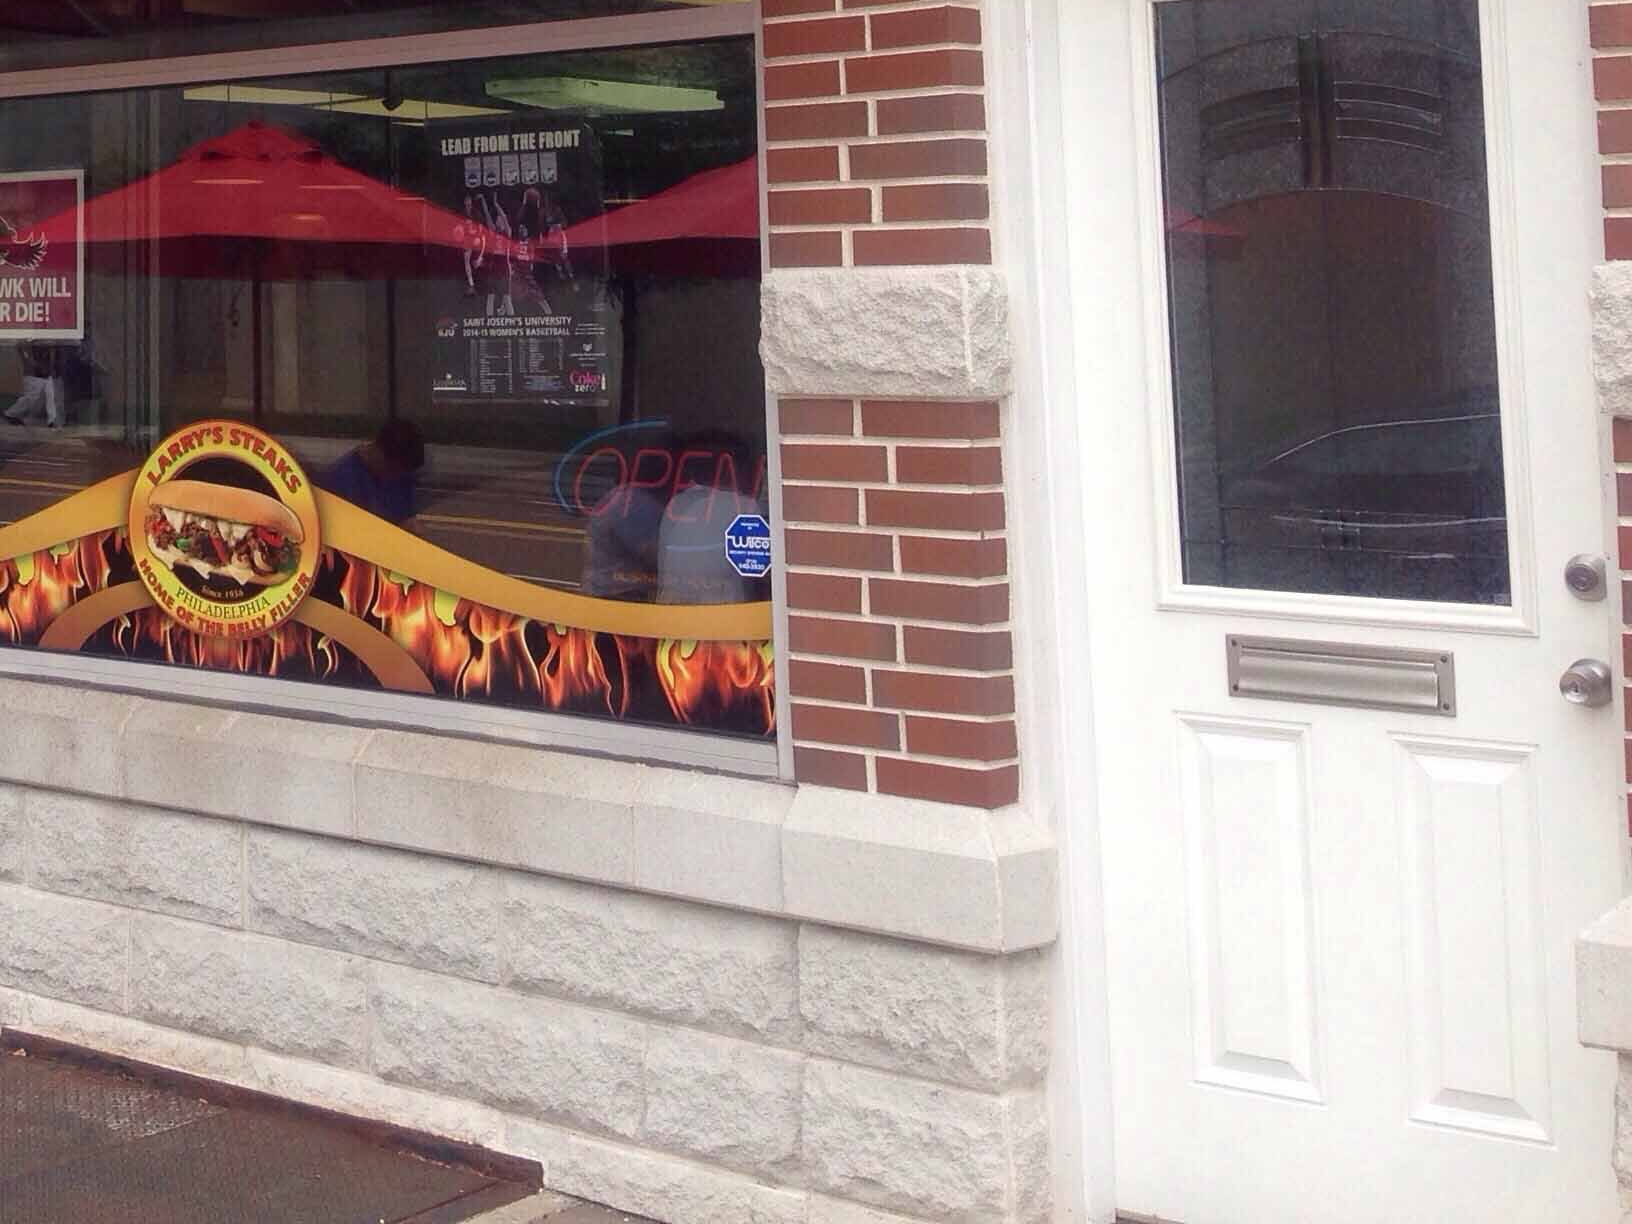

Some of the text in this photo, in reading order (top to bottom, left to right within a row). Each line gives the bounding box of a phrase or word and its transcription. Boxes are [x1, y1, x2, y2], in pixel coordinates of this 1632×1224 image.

[441, 129, 580, 156] LEAD FROM THE FRONT
[29, 277, 71, 297] WILL
[15, 301, 50, 322] DIE!
[463, 316, 572, 328] SAINT JOSEPH'S UNIVERSITY
[489, 327, 524, 337] WOMEN'S
[525, 327, 570, 336] BASKETBALL
[570, 370, 602, 385] Coke
[574, 383, 596, 392] zero
[147, 426, 302, 495] LARRY'S STEAKS
[574, 447, 767, 522] OPEN
[139, 558, 175, 610] HOME
[176, 606, 195, 625] OF
[270, 571, 312, 621] FILLER
[175, 586, 272, 620] PHILADELPHIA
